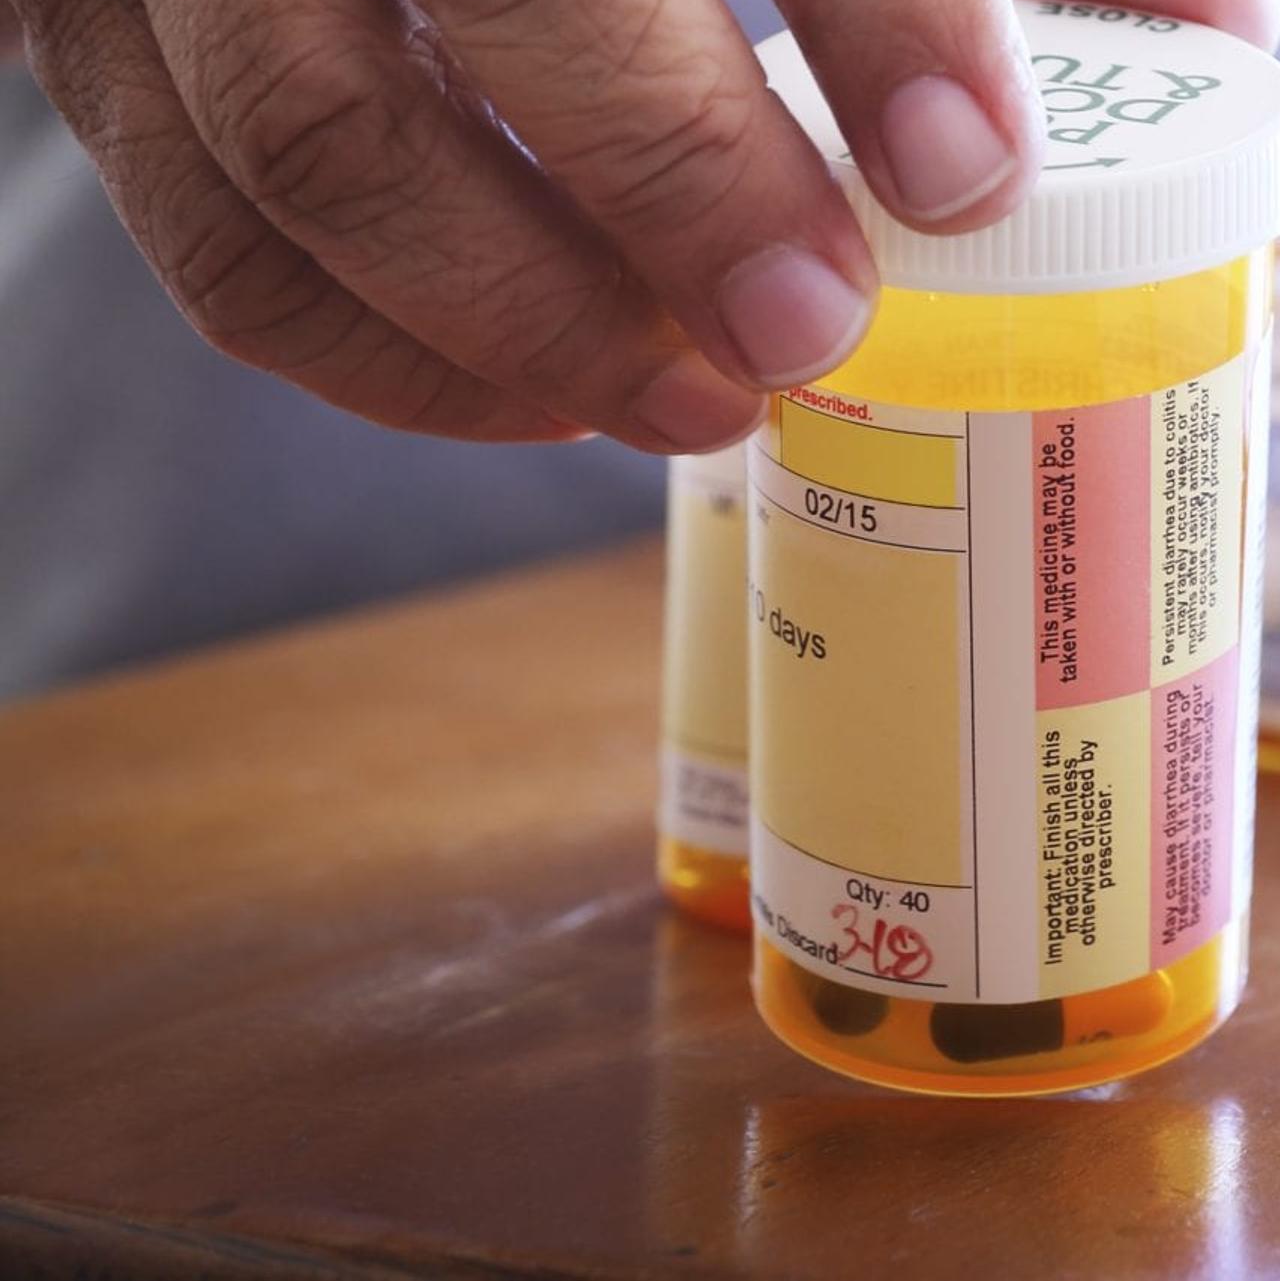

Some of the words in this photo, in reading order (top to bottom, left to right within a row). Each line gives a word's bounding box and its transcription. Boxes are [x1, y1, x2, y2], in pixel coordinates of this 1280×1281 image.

[1037, 0, 1181, 33] CLOSE
[1031, 55, 1131, 91] TU
[1152, 70, 1222, 100] &
[1041, 88, 1184, 125] DO
[789, 386, 873, 422] prescribed.
[1187, 381, 1200, 394] If
[1163, 389, 1176, 442] colitis
[1178, 414, 1188, 430] or
[1199, 388, 1209, 442] doctor
[1039, 443, 1056, 469] be
[1057, 417, 1075, 468] food.
[1164, 447, 1176, 465] to
[1177, 435, 1187, 489] weeks
[1163, 469, 1176, 500] due
[1200, 448, 1210, 486] your
[804, 487, 877, 532] 02/15
[1041, 474, 1060, 516] may
[1057, 475, 1076, 552] without
[1198, 492, 1210, 538] notify
[1163, 505, 1176, 575] diarrhea
[1177, 494, 1187, 542] occur
[1189, 495, 1201, 544] using
[1208, 492, 1218, 586] pharmacist
[1039, 525, 1058, 614] medicine
[1062, 554, 1076, 577] or
[1177, 549, 1188, 595] rarely
[1187, 550, 1198, 586] after
[1058, 581, 1077, 626] with
[1177, 601, 1188, 635] may
[1208, 592, 1217, 608] or
[769, 607, 827, 659] days
[1040, 620, 1059, 663] This
[1162, 580, 1175, 666] Persistent
[1188, 591, 1198, 655] months
[1198, 610, 1207, 643] this
[1059, 628, 1077, 683] taken
[1164, 690, 1180, 753] during
[1180, 694, 1190, 713] or
[1192, 684, 1204, 729] your
[1042, 730, 1060, 768] this
[1079, 740, 1098, 763] by
[1178, 718, 1191, 795] persists
[1190, 731, 1202, 762] tell
[1042, 773, 1060, 795] all
[1061, 758, 1078, 823] unless
[1164, 759, 1177, 837] diarrhea
[1178, 799, 1190, 812] it
[1078, 768, 1094, 847] directed
[1043, 802, 1060, 861] Finish
[1096, 784, 1115, 889] prescriber.
[1062, 829, 1079, 934] medication
[1166, 843, 1177, 900] cause
[1190, 839, 1201, 927] becomes
[846, 878, 892, 911] Qty:
[899, 890, 931, 913] 40
[1043, 869, 1065, 966] Important:
[1079, 853, 1095, 946] otherwise
[1162, 906, 1180, 945] May
